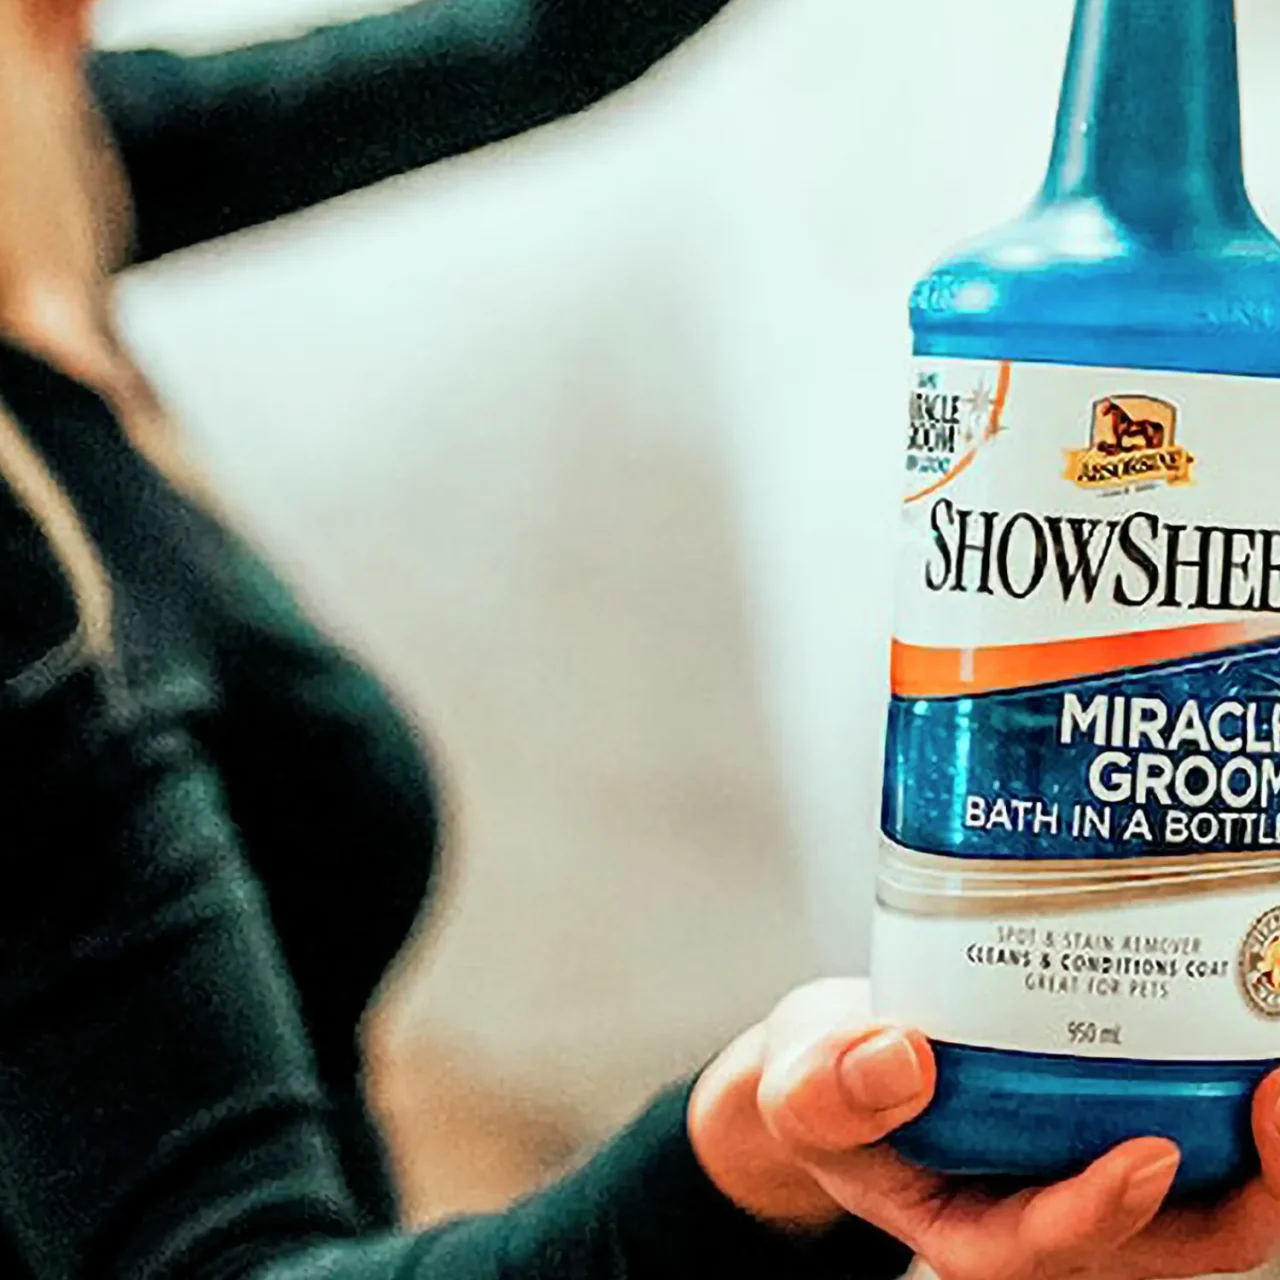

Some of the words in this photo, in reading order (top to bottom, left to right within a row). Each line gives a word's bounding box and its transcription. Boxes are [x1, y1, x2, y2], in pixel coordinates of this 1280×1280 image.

[965, 795, 1058, 836] BATH
[1072, 805, 1111, 840] IN
[1122, 811, 1153, 842] A
[997, 926, 1037, 946] SPOT
[1045, 930, 1055, 948] &
[1063, 931, 1115, 951] STAIN
[1121, 934, 1202, 955] REMOVER
[966, 943, 1032, 968] CLEANS
[1039, 950, 1051, 969] &
[1060, 953, 1178, 978] CONDITIONS
[1186, 960, 1229, 979] COAT
[1025, 972, 1079, 995] GREAT
[1088, 977, 1120, 996] FOR
[1130, 981, 1169, 999] PETS
[1067, 1021, 1096, 1045] 950
